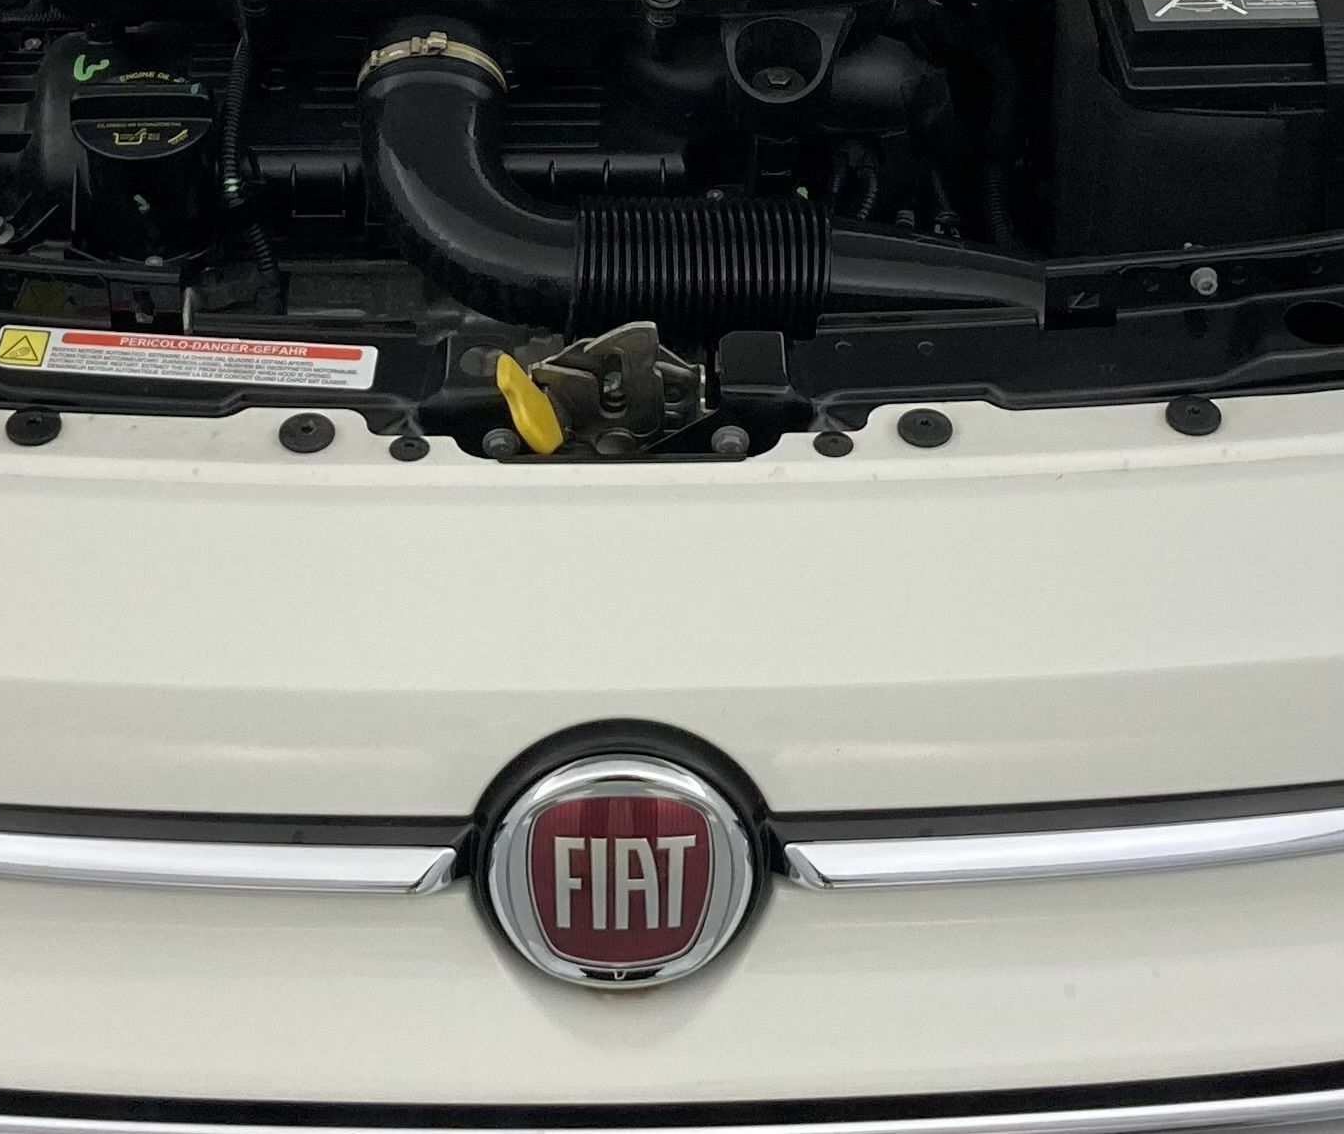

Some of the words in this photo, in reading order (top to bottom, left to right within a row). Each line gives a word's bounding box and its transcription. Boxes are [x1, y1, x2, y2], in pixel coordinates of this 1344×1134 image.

[118, 71, 156, 83] ENGINE
[157, 71, 171, 81] OIL
[119, 336, 308, 356] PERICOLO-DANGER-GEFAHR
[554, 835, 697, 931] FIAT
